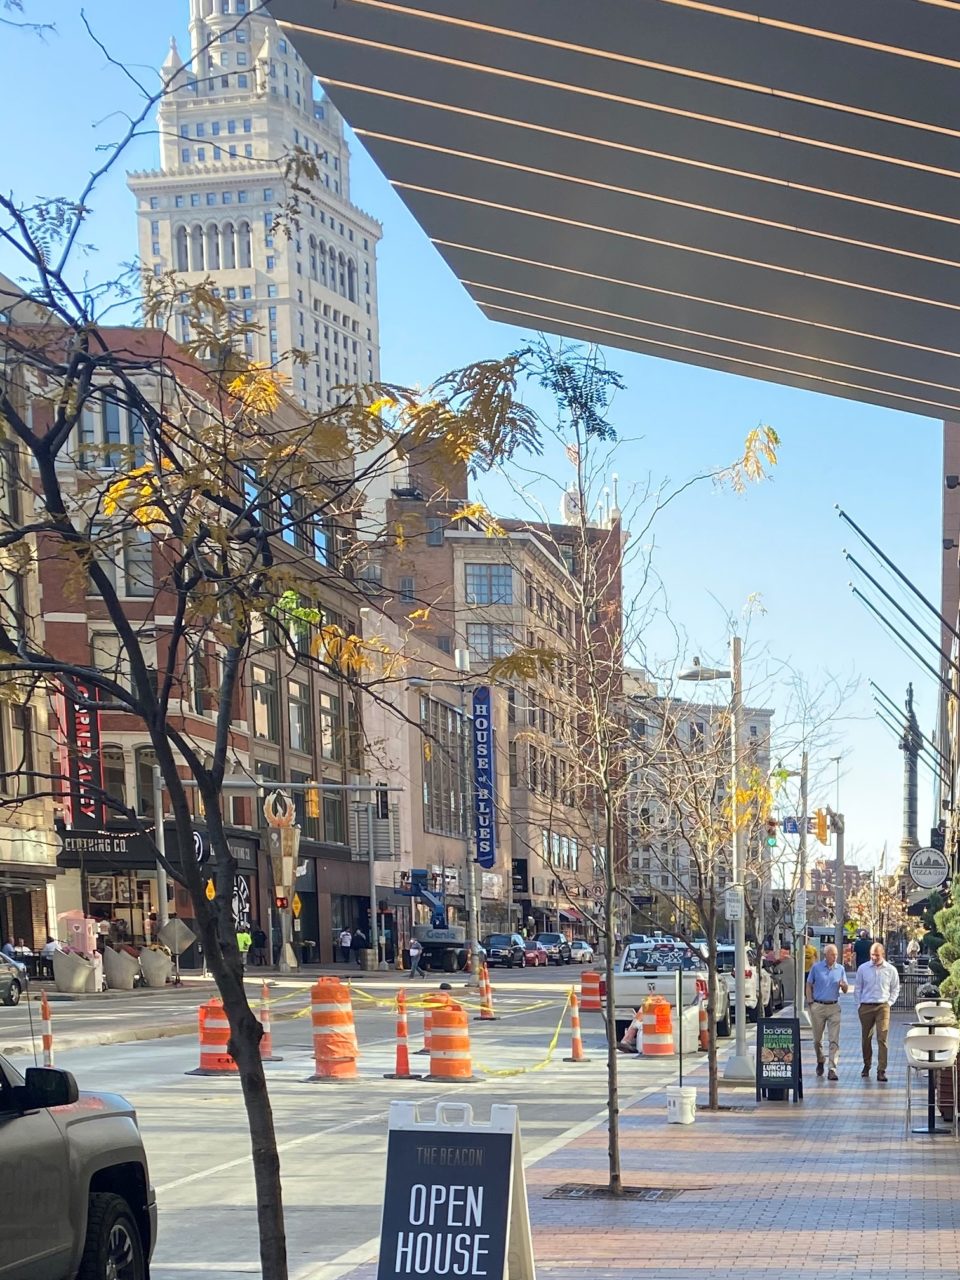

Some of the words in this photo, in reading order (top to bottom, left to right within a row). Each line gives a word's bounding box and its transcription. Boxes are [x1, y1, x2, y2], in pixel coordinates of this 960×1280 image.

[475, 704, 489, 769] HOUSE
[78, 763, 96, 819] ALLEY
[477, 788, 491, 853] BLUES
[64, 837, 111, 852] CLOTHING
[114, 838, 129, 852] CO.
[426, 929, 456, 940] Genie
[763, 1025, 793, 1035] baance
[762, 1070, 792, 1078] DINNER
[416, 1147, 437, 1166] THE
[440, 1148, 483, 1167] BEACON
[409, 1183, 484, 1227] OPEN
[394, 1231, 490, 1276] HOUSE
